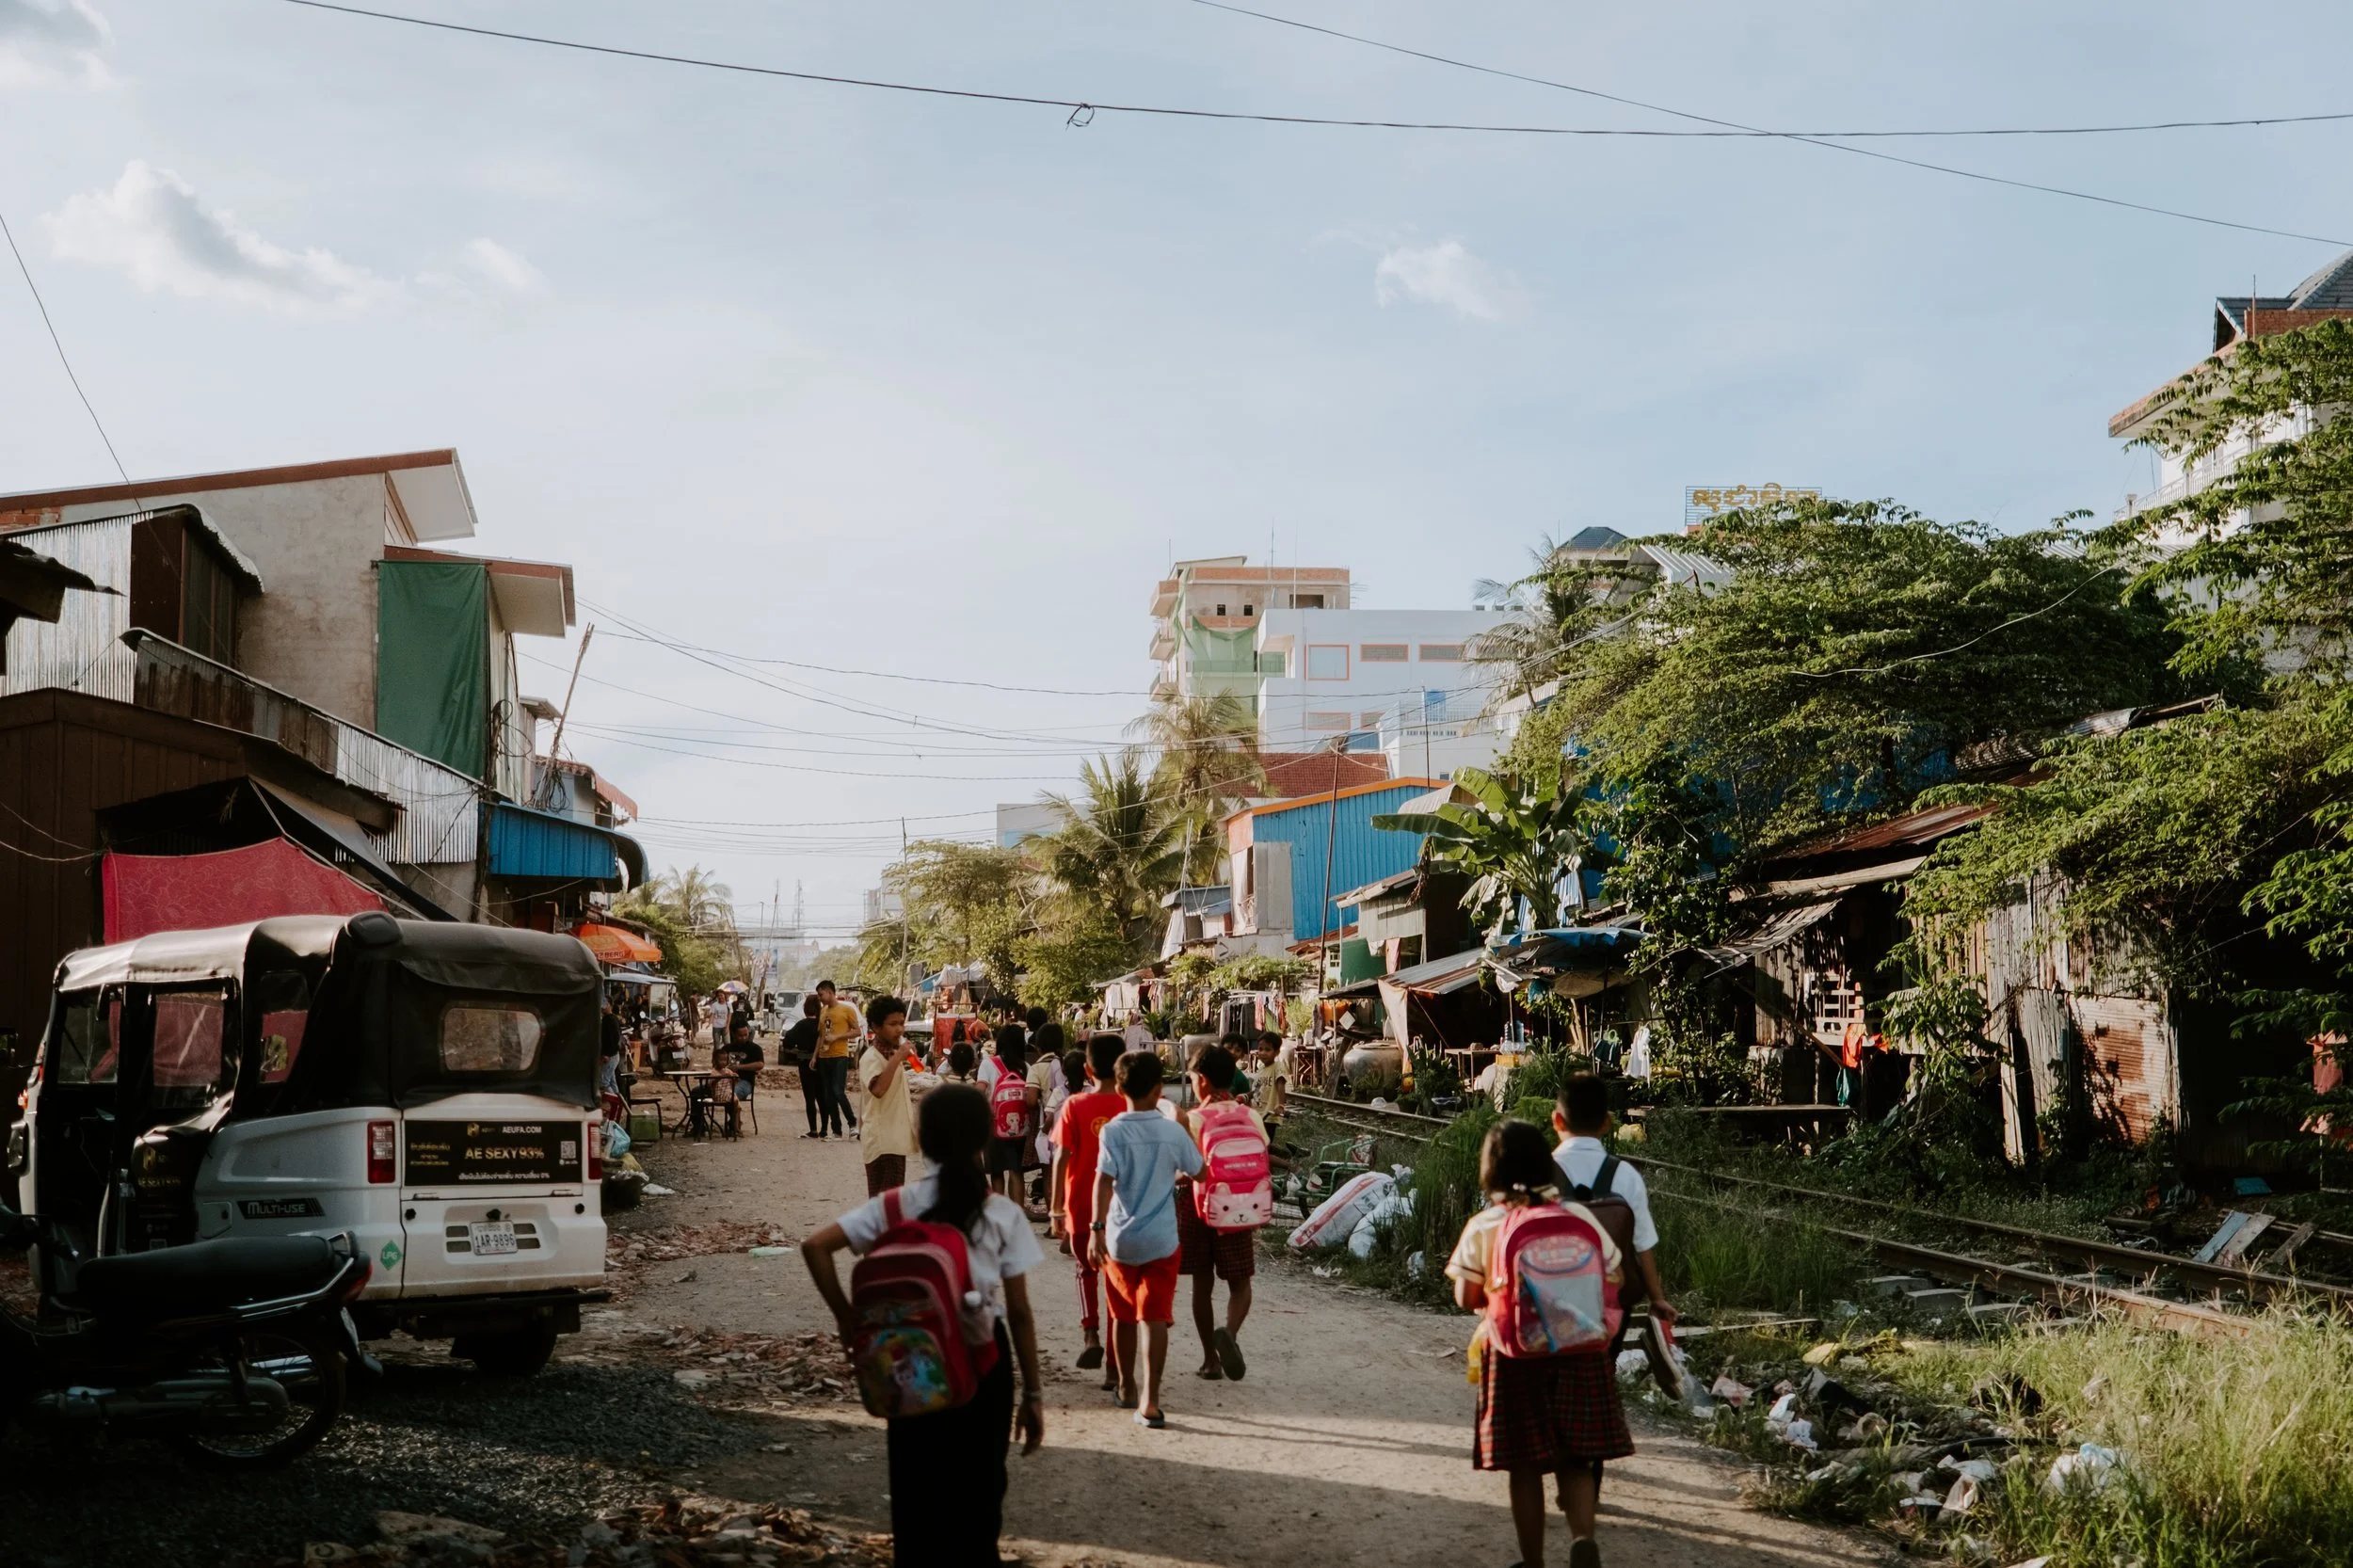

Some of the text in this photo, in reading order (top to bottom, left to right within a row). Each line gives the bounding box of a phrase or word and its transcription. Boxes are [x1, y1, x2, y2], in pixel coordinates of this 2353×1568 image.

[502, 1126, 542, 1134] AEUFA.COM
[465, 1147, 483, 1159] AE
[485, 1147, 518, 1159] SEXY
